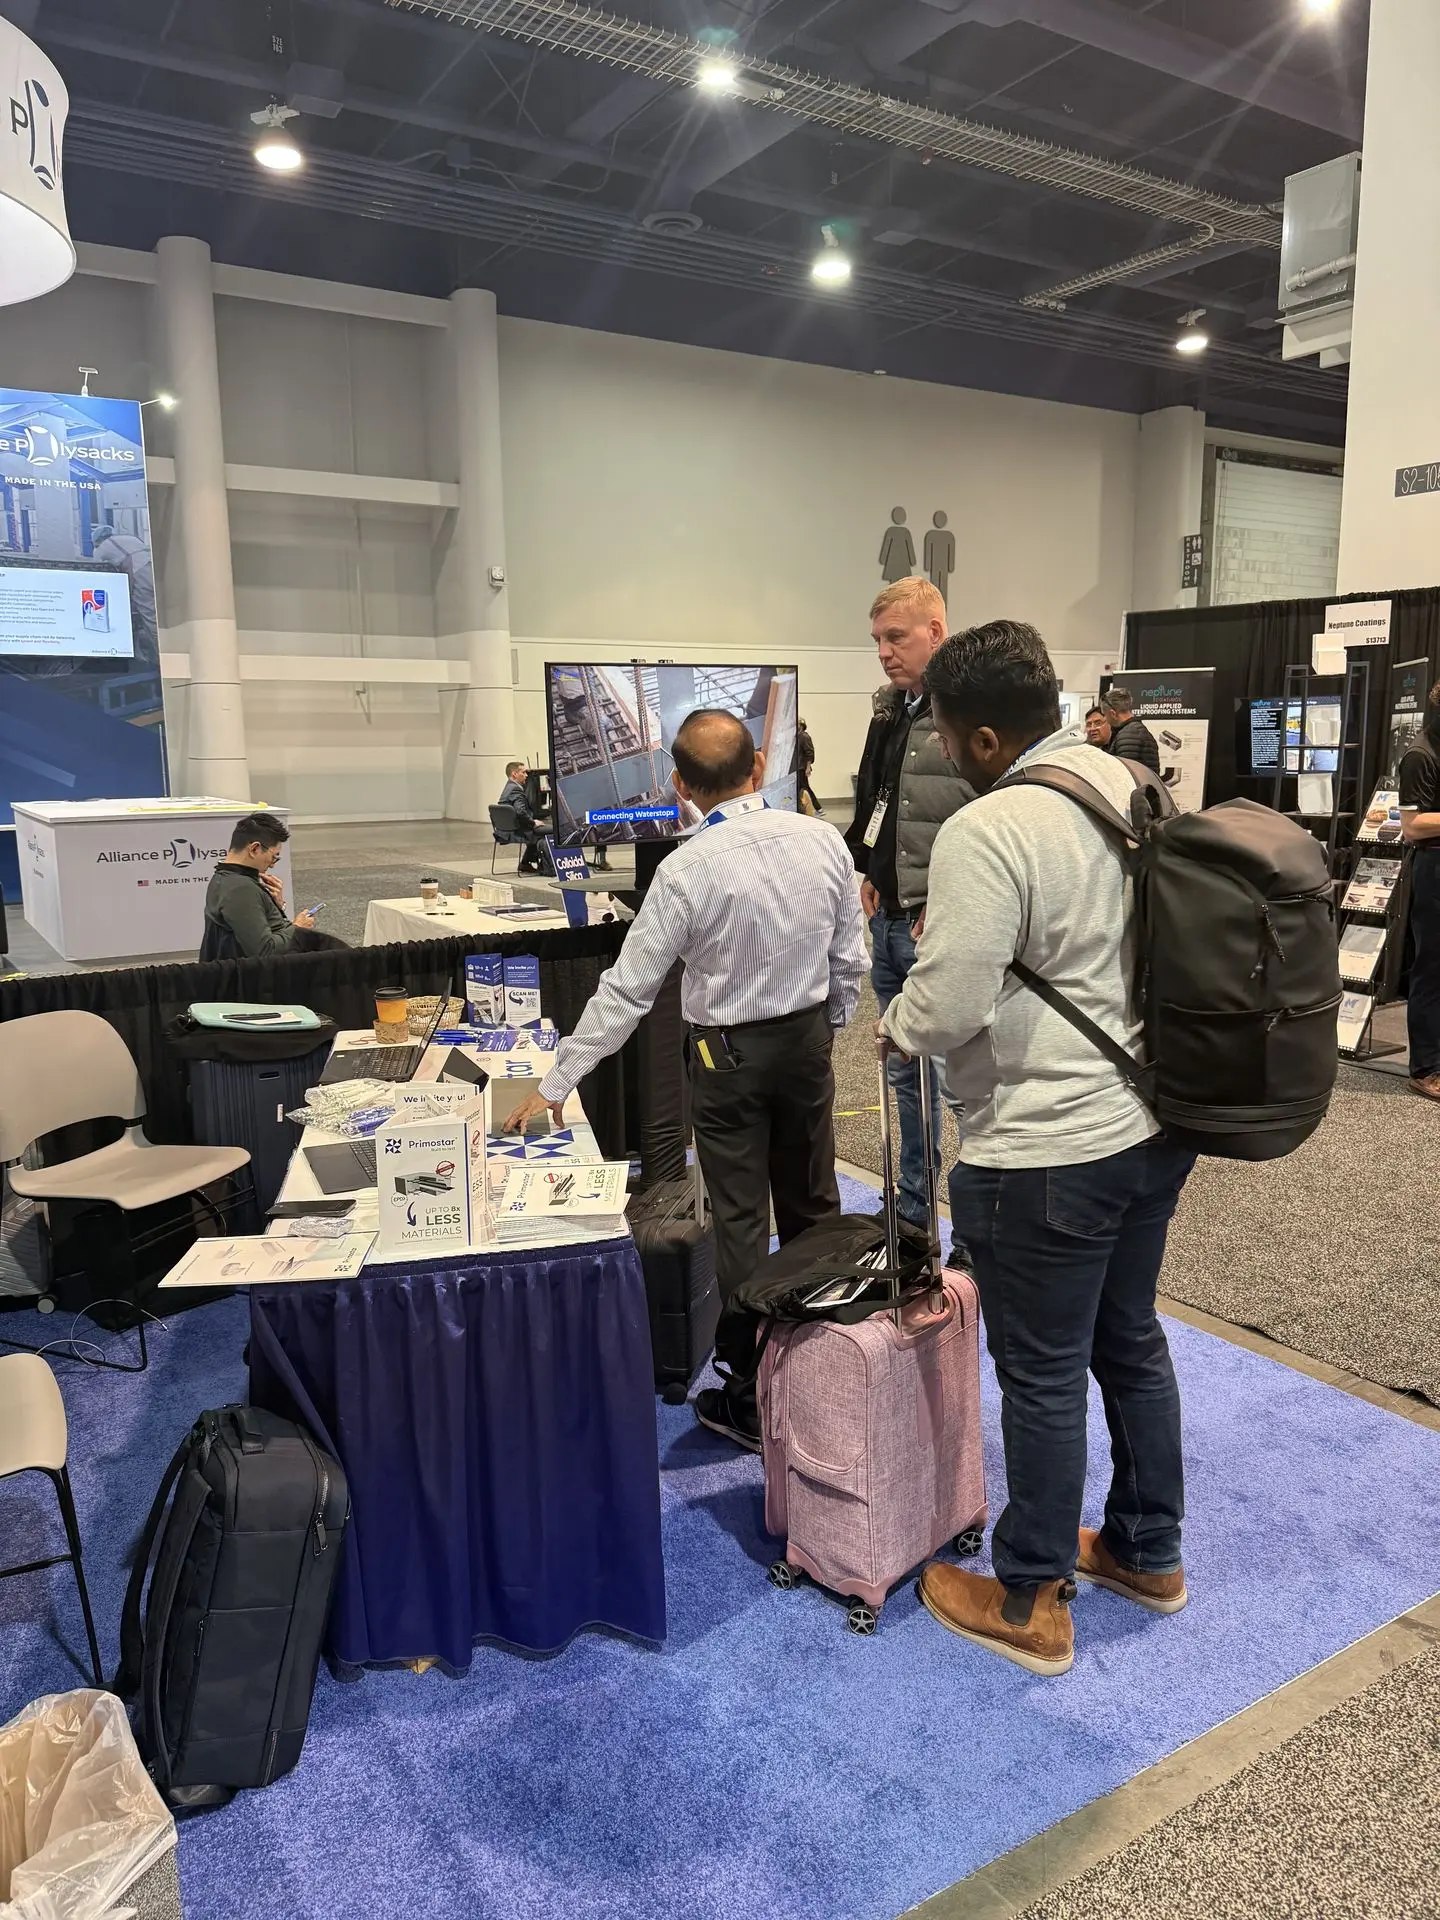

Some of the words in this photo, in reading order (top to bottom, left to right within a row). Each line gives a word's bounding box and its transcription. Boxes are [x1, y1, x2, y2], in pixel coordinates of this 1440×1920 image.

[5, 476, 37, 486] MADE
[54, 481, 77, 489] THE
[79, 483, 102, 491] USA
[1328, 621, 1355, 630] Neptune
[1355, 619, 1387, 627] Coatings
[1141, 684, 1183, 699] neptune
[592, 811, 634, 821] Connecting
[635, 810, 674, 819] Waterstops
[97, 851, 159, 863] Alliance
[556, 856, 585, 870] Colloidal
[403, 1096, 419, 1104] We
[446, 1094, 466, 1103] yu!
[408, 1139, 456, 1149] Primostar
[593, 1168, 606, 1189] LESS
[426, 1213, 461, 1226] LESS
[401, 1226, 462, 1239] MATERIALS
